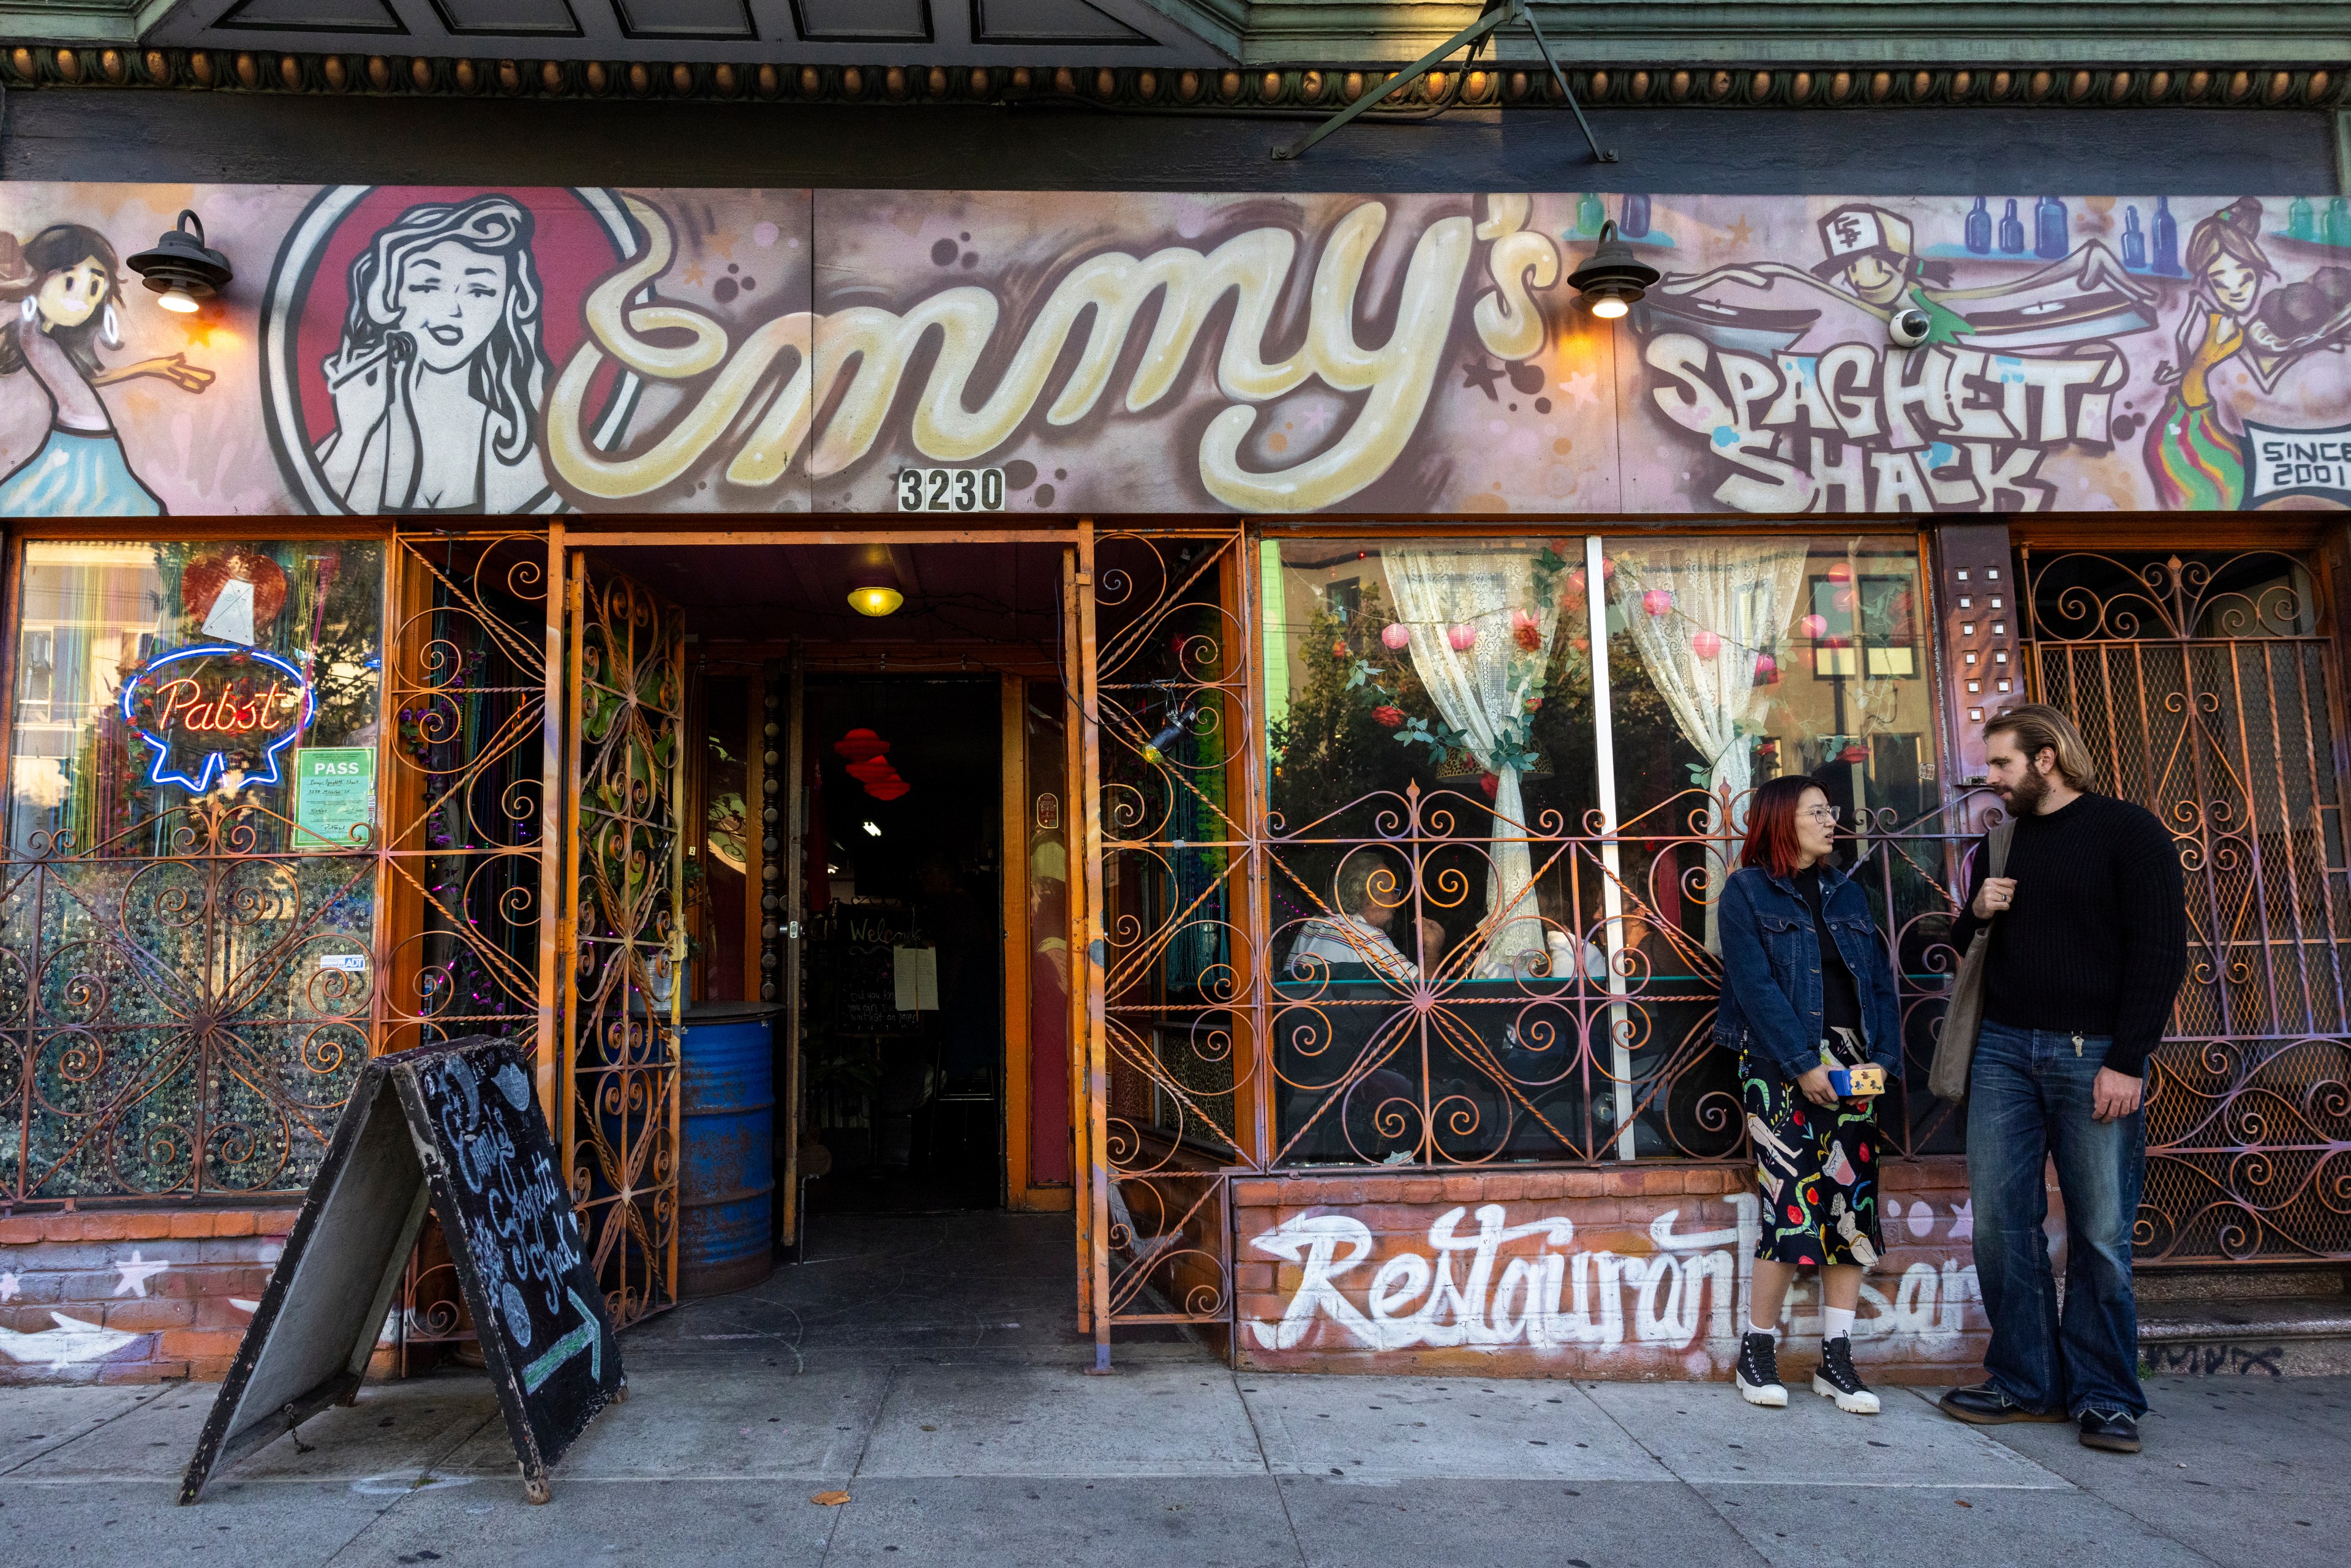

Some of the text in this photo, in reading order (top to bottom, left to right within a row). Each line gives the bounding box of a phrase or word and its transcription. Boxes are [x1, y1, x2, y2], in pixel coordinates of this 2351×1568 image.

[547, 193, 1559, 513] Emmy's
[1711, 426, 2042, 512] SHACK
[2263, 441, 2351, 463] SINCE
[2274, 463, 2345, 487] 2001
[900, 471, 1005, 512] 3230
[155, 678, 286, 732] Pabst
[315, 762, 359, 775] PASS
[345, 958, 363, 967] ADT
[848, 1004, 861, 1015] you
[862, 1003, 878, 1013] can
[851, 989, 865, 1002] Did
[867, 992, 881, 1005] you
[442, 1102, 517, 1205] Emmy's
[489, 1150, 559, 1281] Spaghetti
[529, 1210, 581, 1315] Shack
[1249, 1191, 1761, 1352] Restaurant
